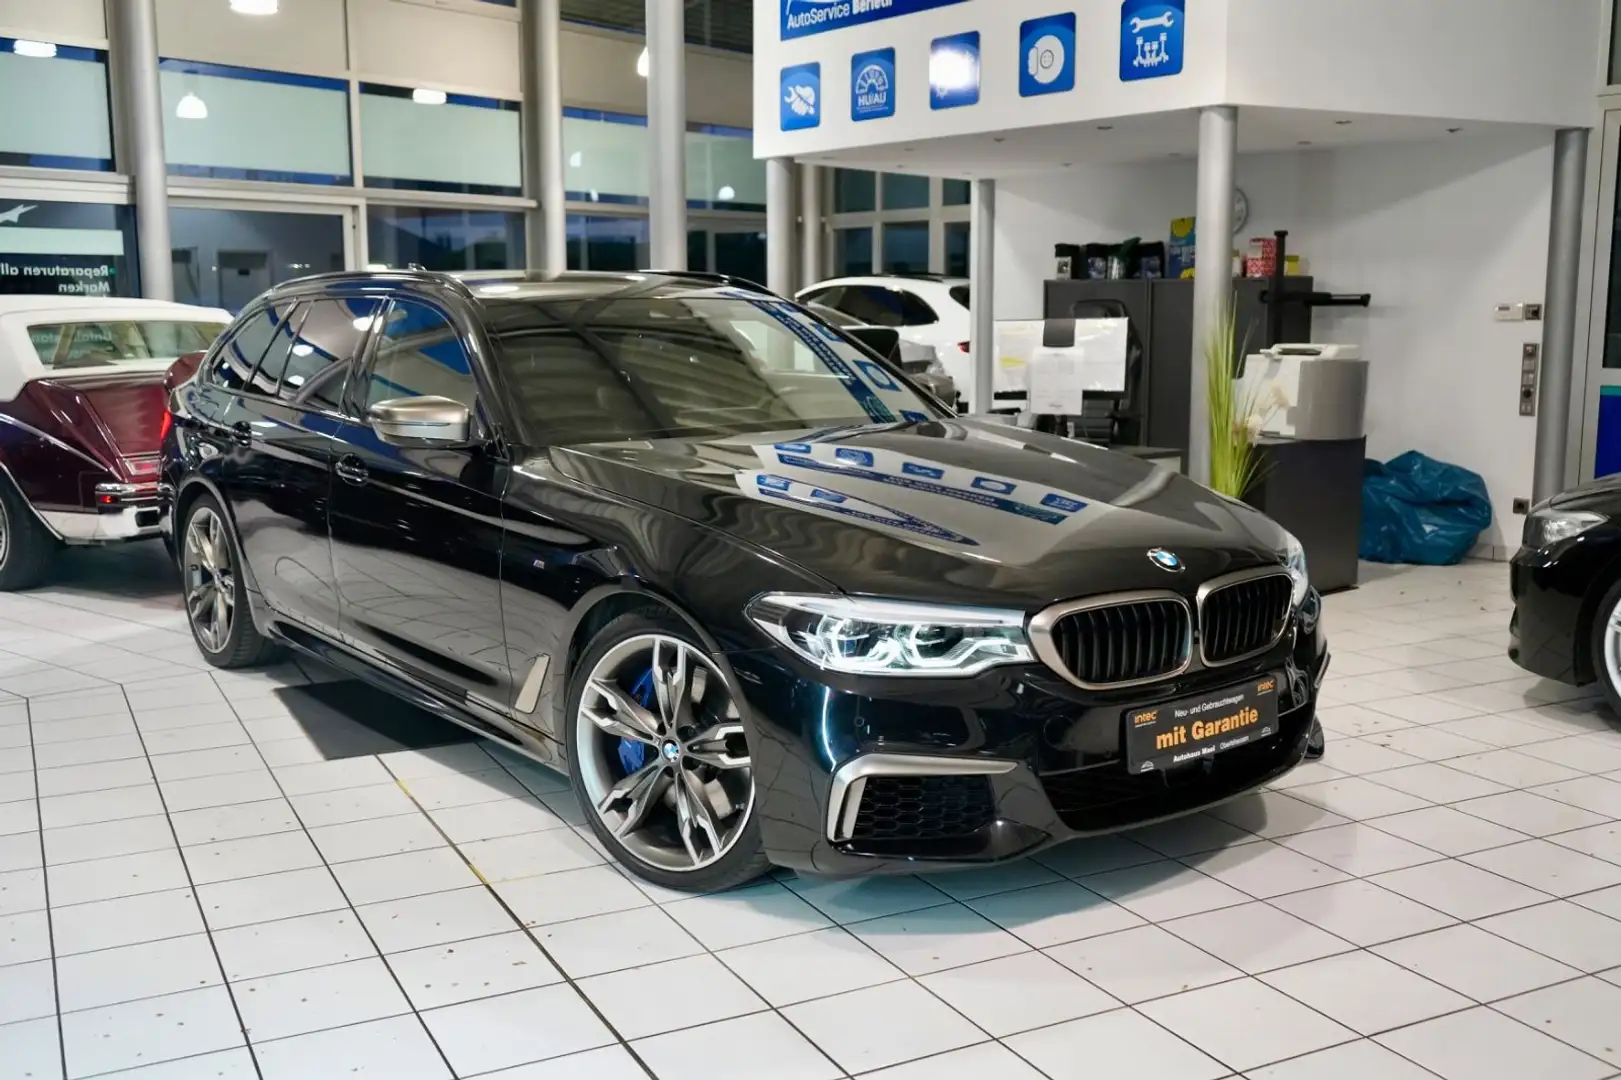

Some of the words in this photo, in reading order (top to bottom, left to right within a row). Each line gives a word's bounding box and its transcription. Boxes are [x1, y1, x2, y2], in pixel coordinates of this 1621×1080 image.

[787, 2, 850, 30] AutoService
[1156, 725, 1187, 750] mit
[1191, 706, 1259, 740] Garantie
[1173, 751, 1200, 763] Autohaus
